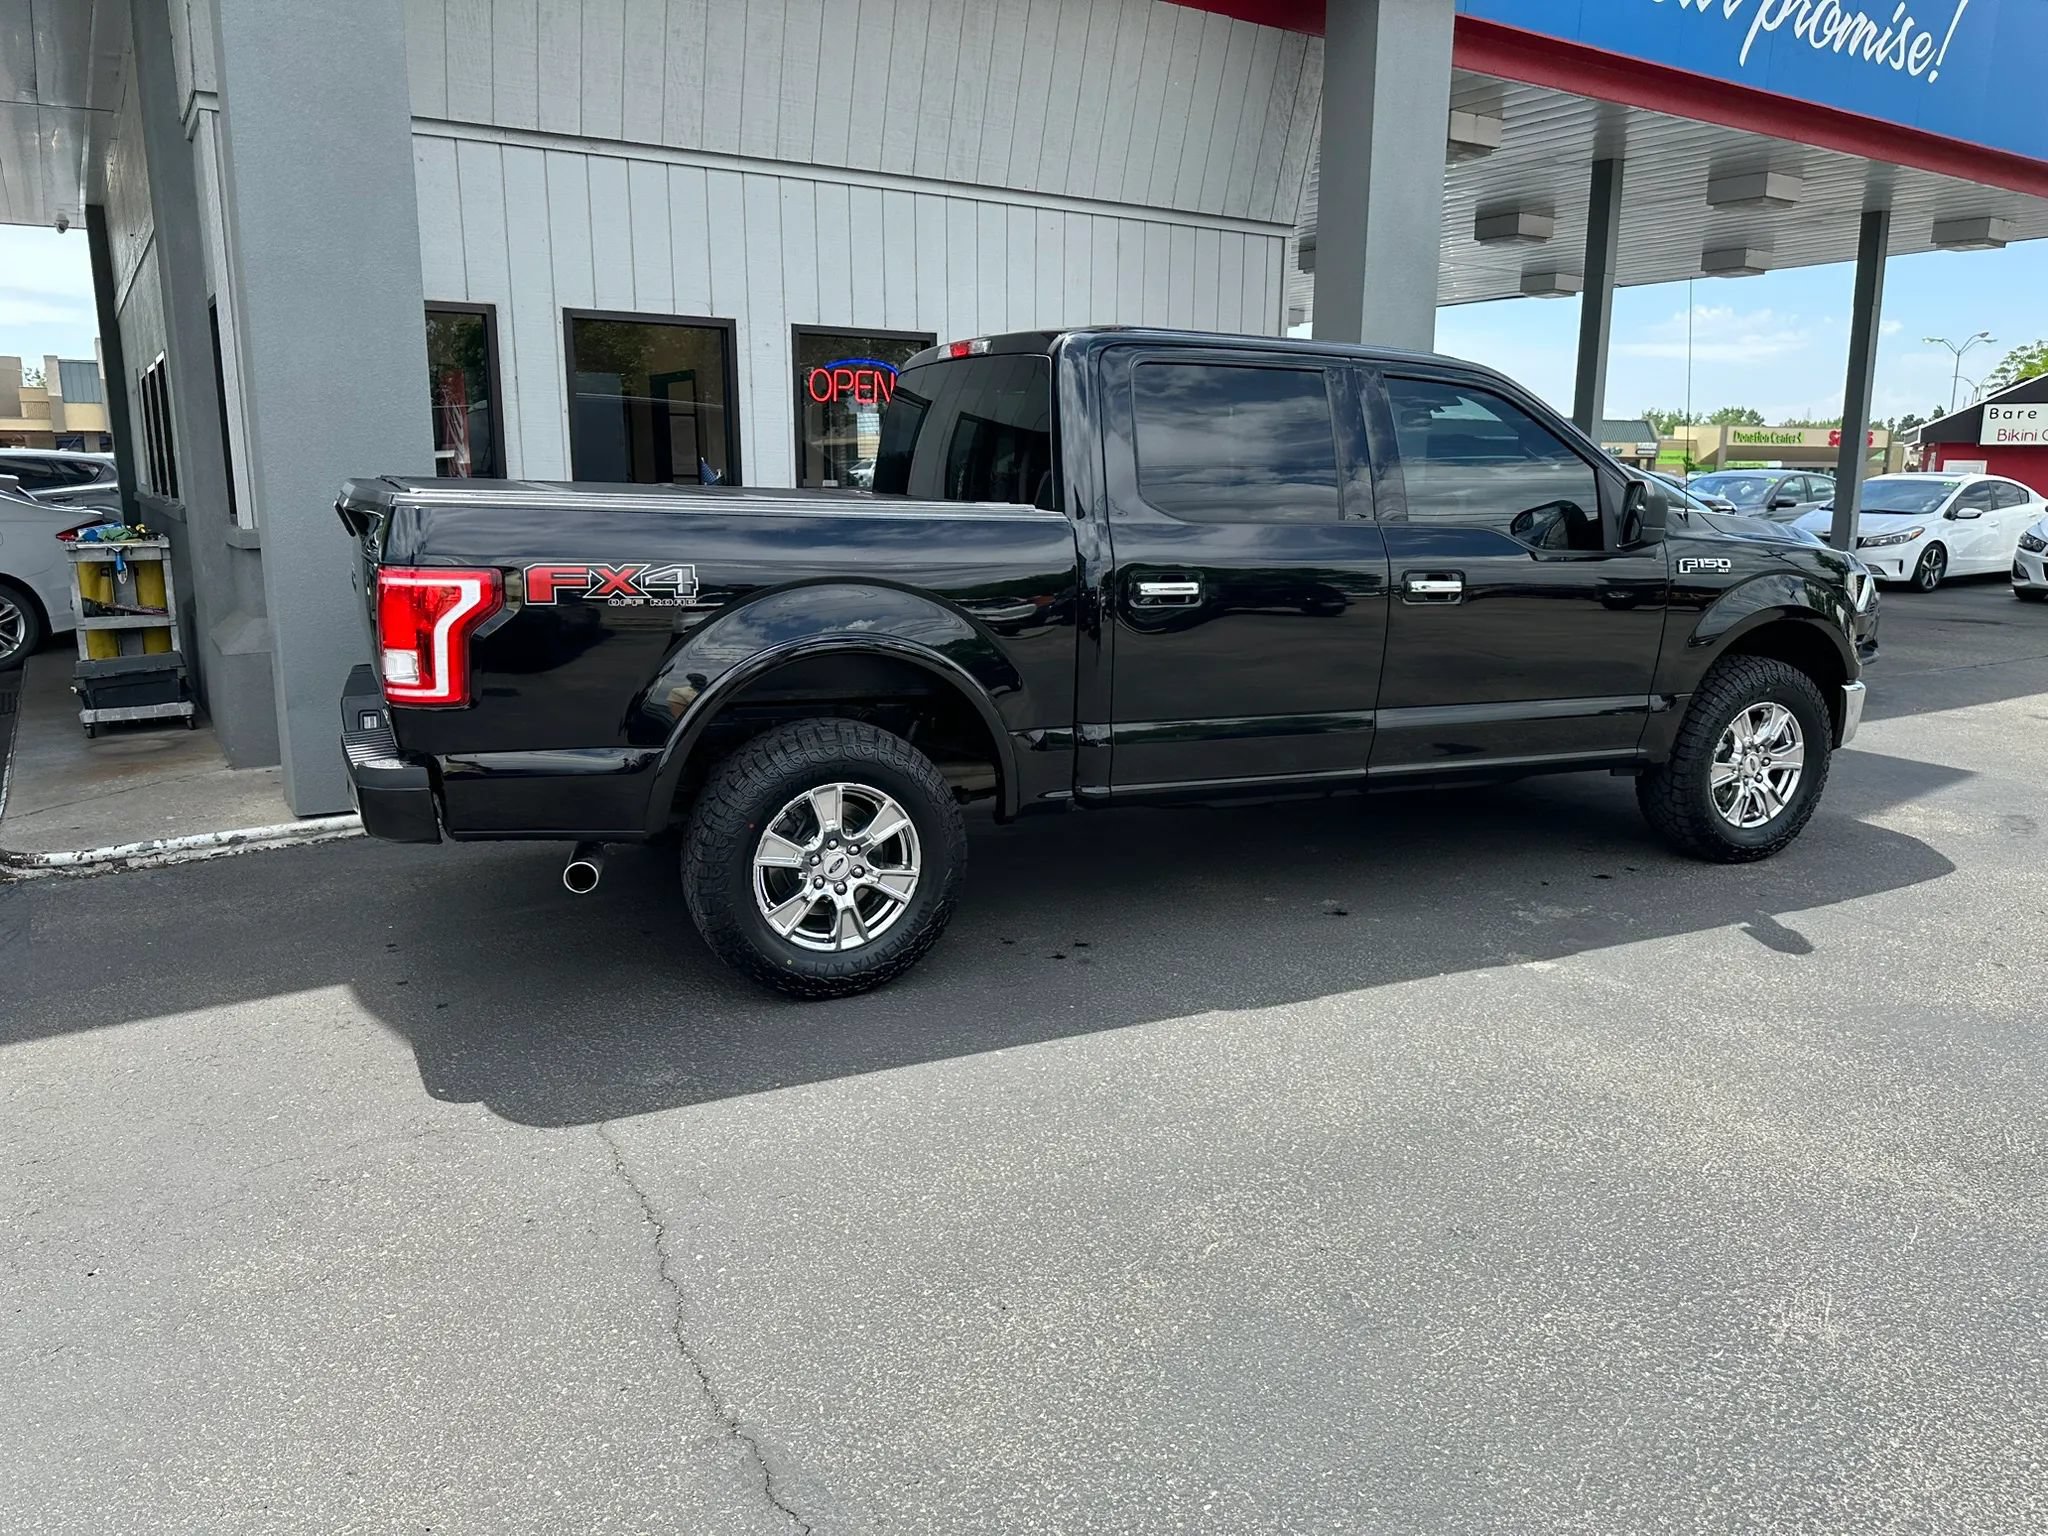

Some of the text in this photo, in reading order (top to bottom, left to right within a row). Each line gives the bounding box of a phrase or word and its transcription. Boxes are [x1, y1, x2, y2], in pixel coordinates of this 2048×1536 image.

[1738, 0, 1970, 84] promise!
[808, 367, 895, 403] OPEN
[1988, 407, 2037, 419] Bare
[1996, 428, 2038, 442] Bikini
[523, 562, 699, 606] FX4
[607, 598, 697, 607] OFF ROAD
